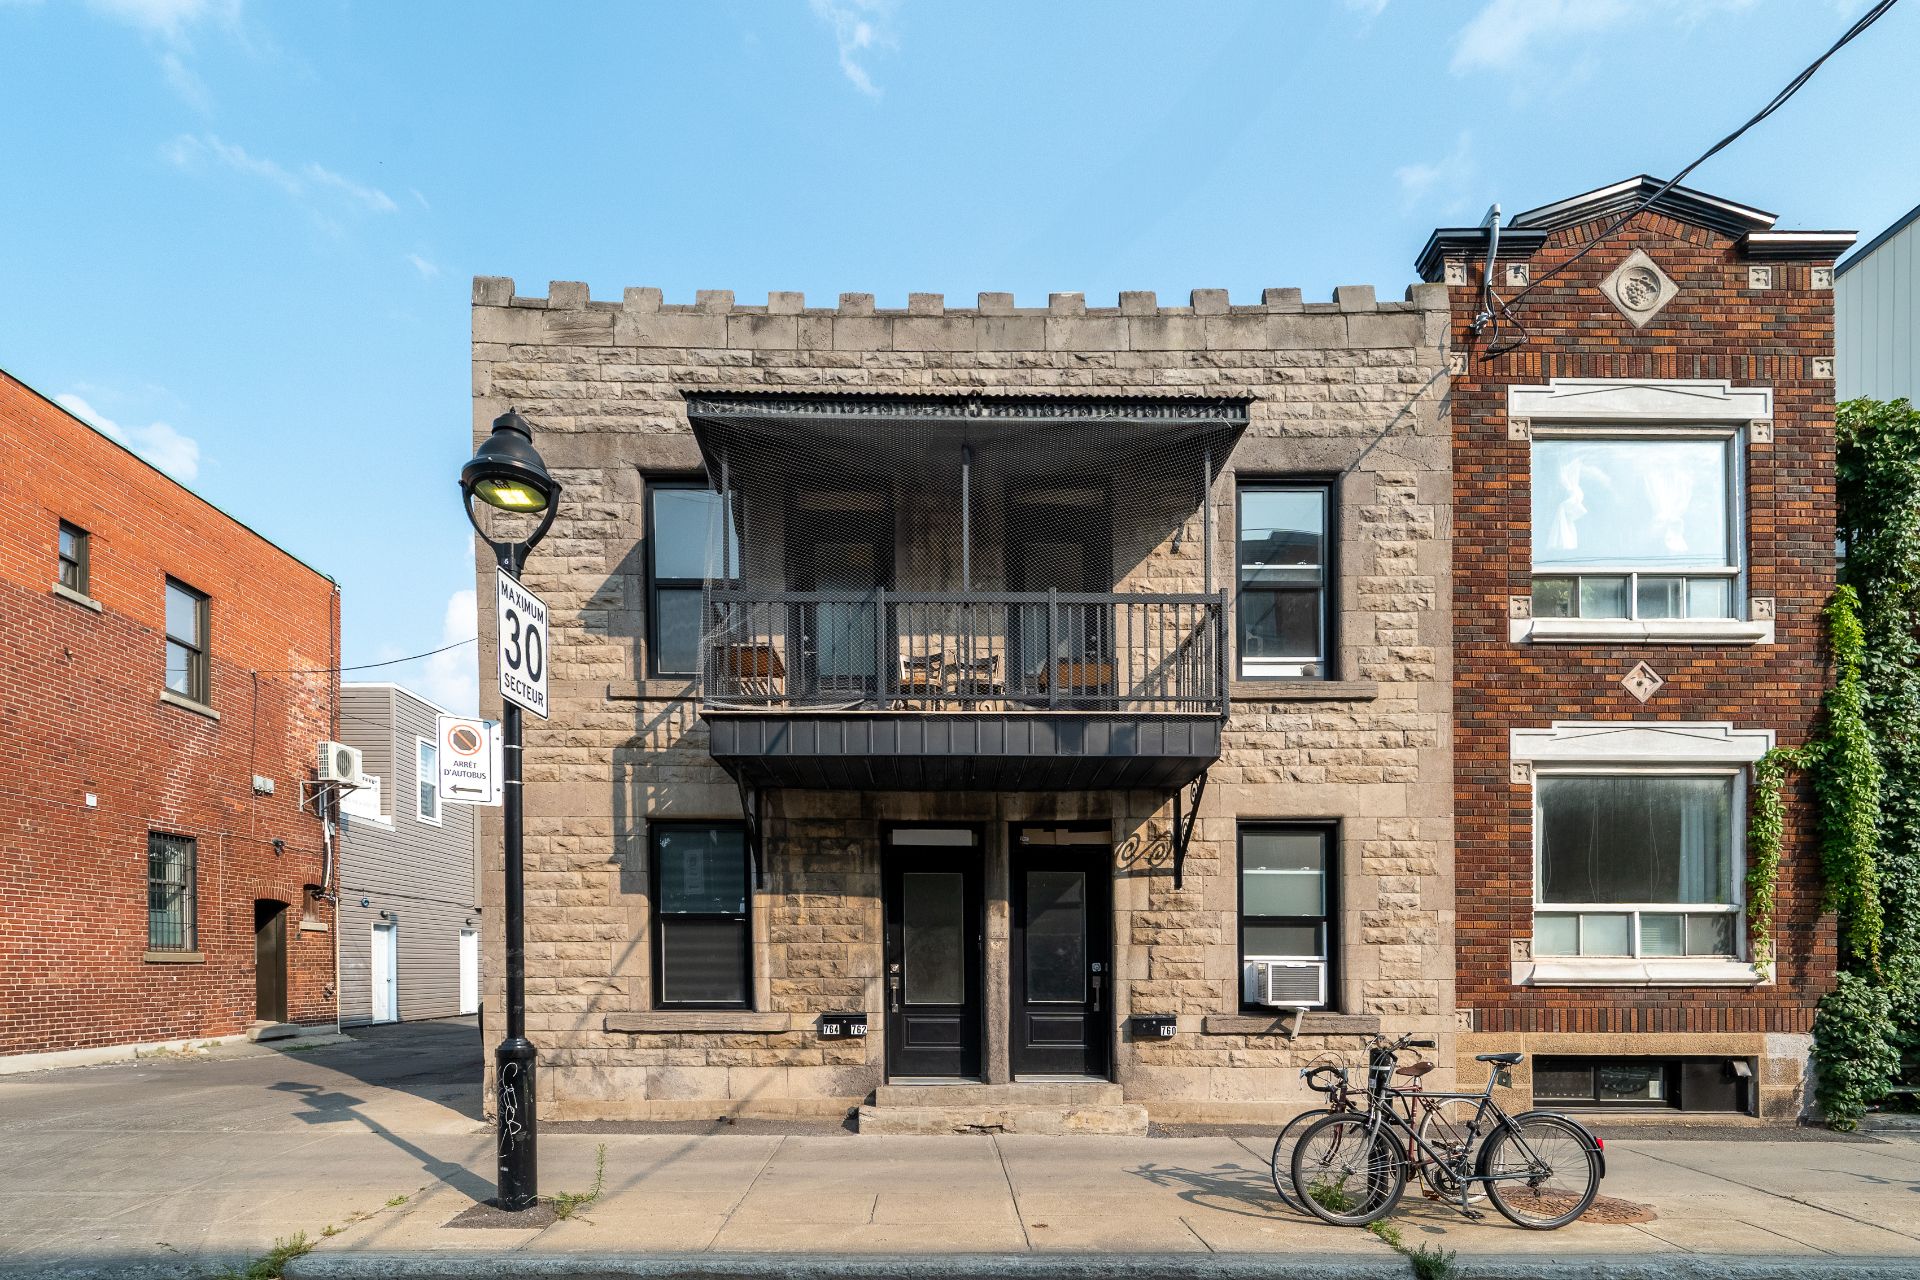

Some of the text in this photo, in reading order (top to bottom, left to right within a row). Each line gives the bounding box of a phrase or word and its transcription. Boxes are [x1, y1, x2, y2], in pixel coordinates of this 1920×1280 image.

[501, 580, 544, 625] MAXIMUM
[504, 608, 543, 683] 30
[504, 672, 544, 708] SECTEUR
[453, 760, 477, 769] ARRÊT
[443, 769, 487, 780] D'AUTOBUS
[824, 1024, 867, 1034] 764 762
[1161, 1026, 1176, 1036] 760
